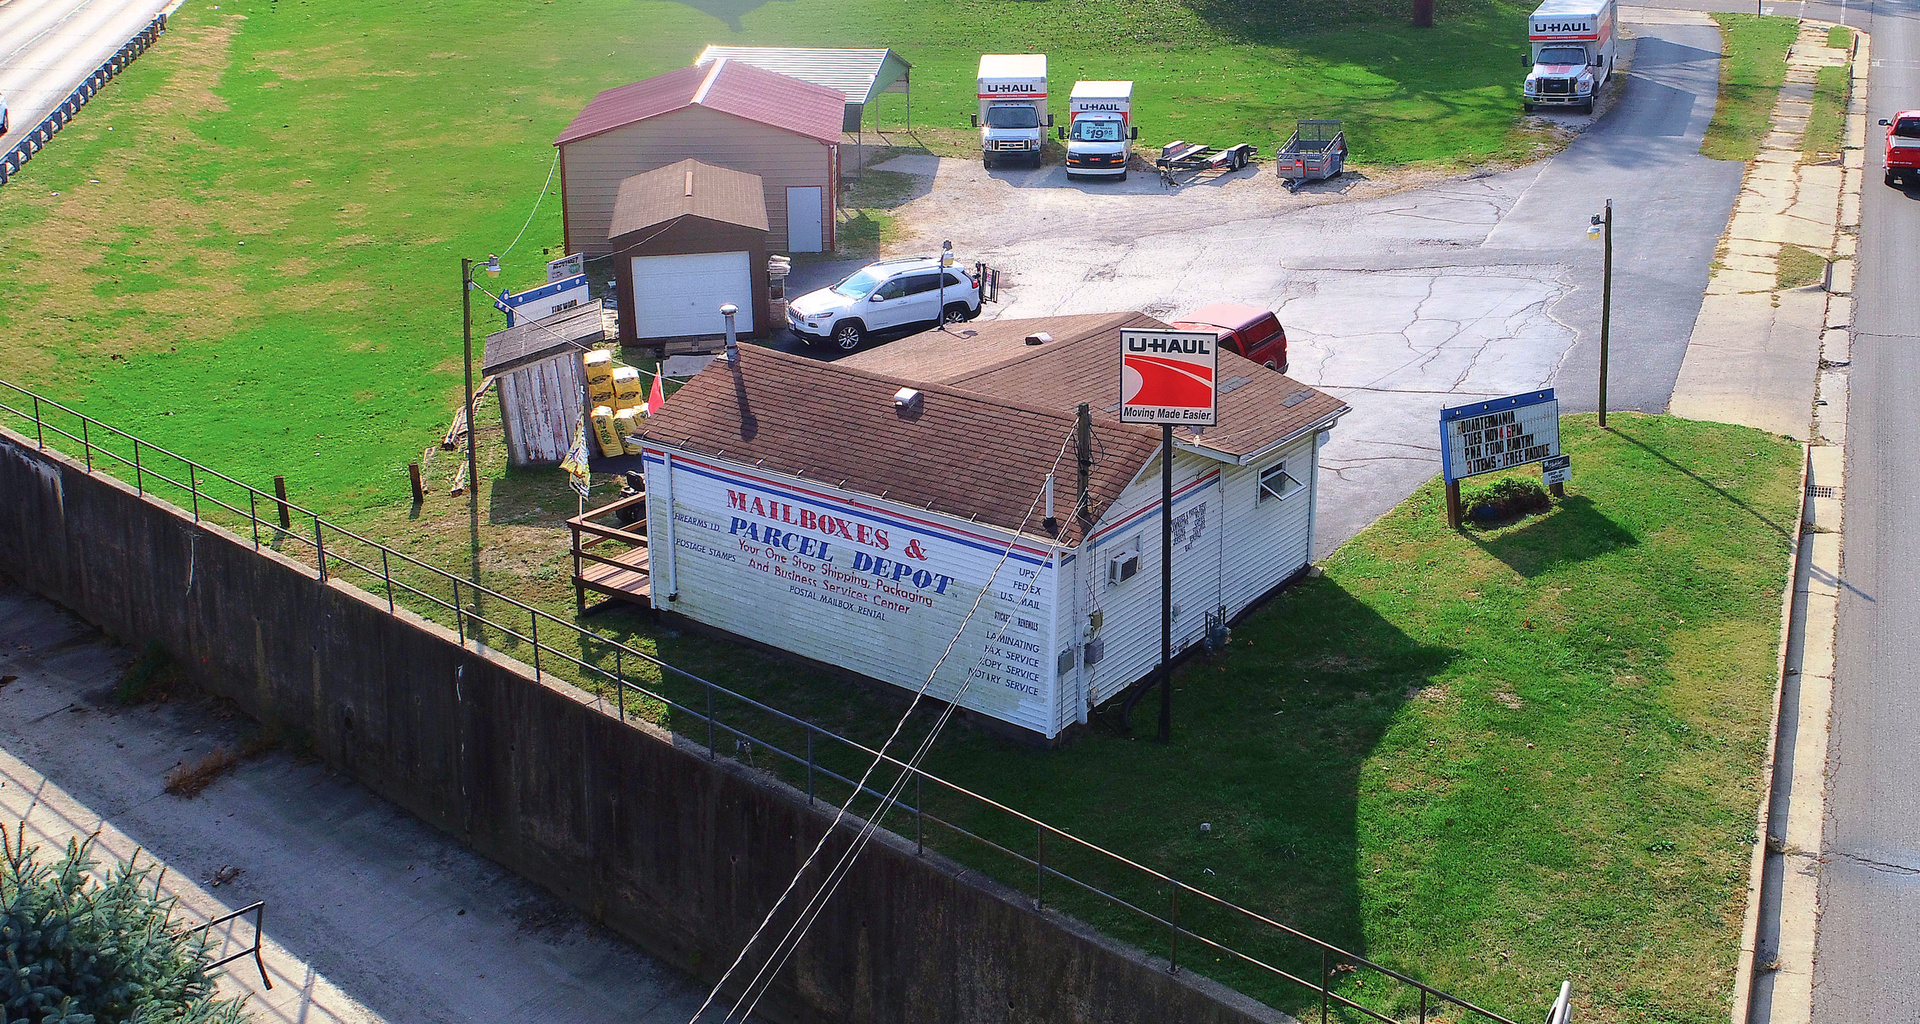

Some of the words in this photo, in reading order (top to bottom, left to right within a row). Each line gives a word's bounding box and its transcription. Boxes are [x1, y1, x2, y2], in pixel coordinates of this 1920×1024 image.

[1535, 23, 1590, 32] U-HAUL
[988, 84, 1037, 92] U-HAUL
[1129, 338, 1210, 354] U-HAUL
[1124, 407, 1154, 420] Moving
[1157, 408, 1180, 418] Made
[1463, 430, 1482, 447] TUES
[1485, 428, 1498, 443] NOV
[1485, 440, 1504, 456] FOOD
[674, 512, 708, 528] FIREARMS
[726, 489, 890, 550] MAILBOXES
[904, 538, 928, 561] &
[676, 538, 706, 554] POSTAGE
[708, 548, 736, 562] STAMPS
[728, 516, 834, 562] PARCEL
[852, 550, 954, 595] DEPOT
[739, 539, 760, 555] Your
[765, 548, 787, 564] One
[792, 555, 816, 572] Stop
[822, 563, 872, 589] Shipping,
[876, 579, 932, 608] Packaging
[1019, 568, 1036, 579] UPS
[748, 558, 769, 572] And
[774, 565, 817, 587] Business
[823, 580, 868, 602] Services
[874, 595, 910, 614] Center
[790, 586, 816, 600] POSTAL
[820, 595, 854, 611] MAILBOX
[858, 606, 886, 620] RENTAL
[1000, 592, 1014, 602] U.S.
[986, 631, 1040, 653] LAMINATING
[1006, 651, 1040, 668] SERVICE
[1006, 666, 1040, 682] SERVICE
[1005, 679, 1038, 696] SERVICE
